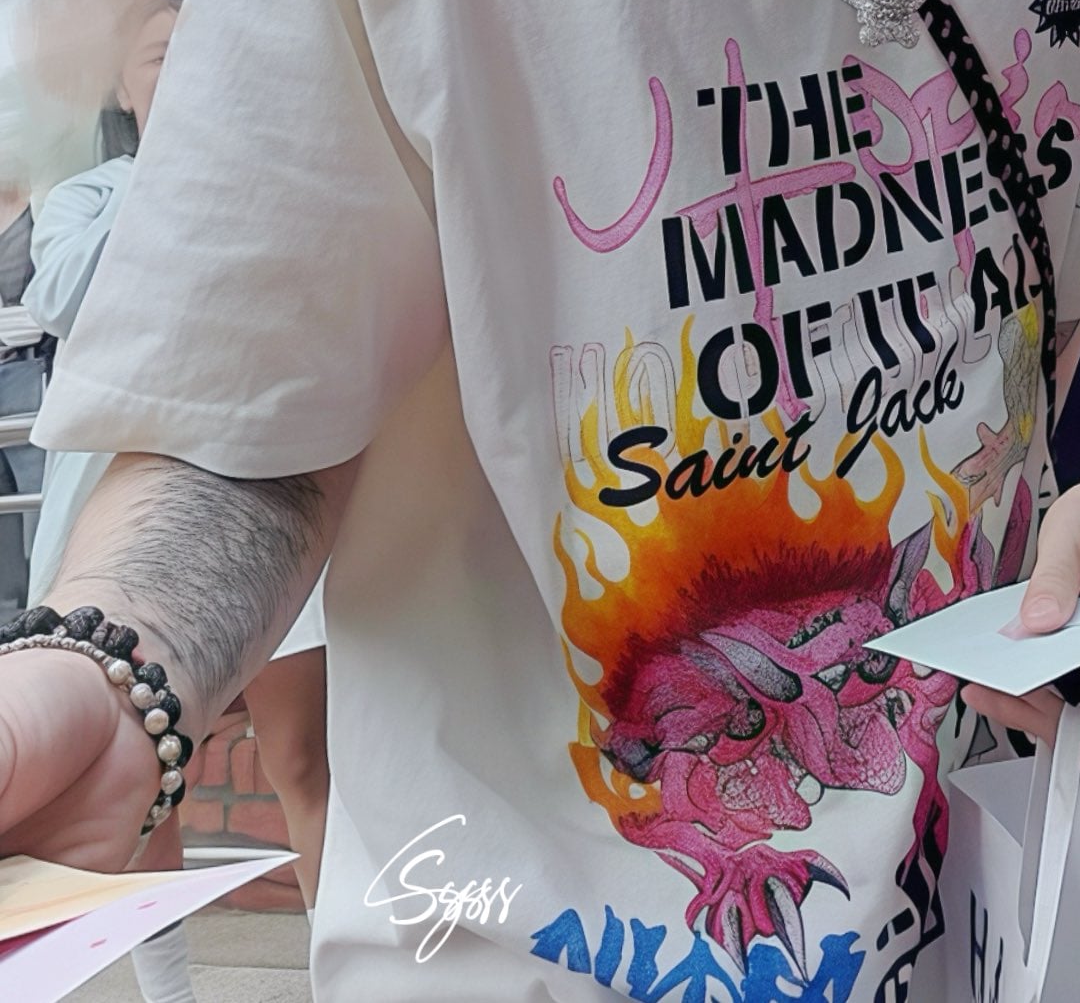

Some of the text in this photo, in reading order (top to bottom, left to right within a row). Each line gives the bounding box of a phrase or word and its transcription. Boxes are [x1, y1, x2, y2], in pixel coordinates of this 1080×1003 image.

[697, 62, 875, 176] THE
[697, 300, 832, 421] OF
[599, 340, 965, 509] Saint Jack
